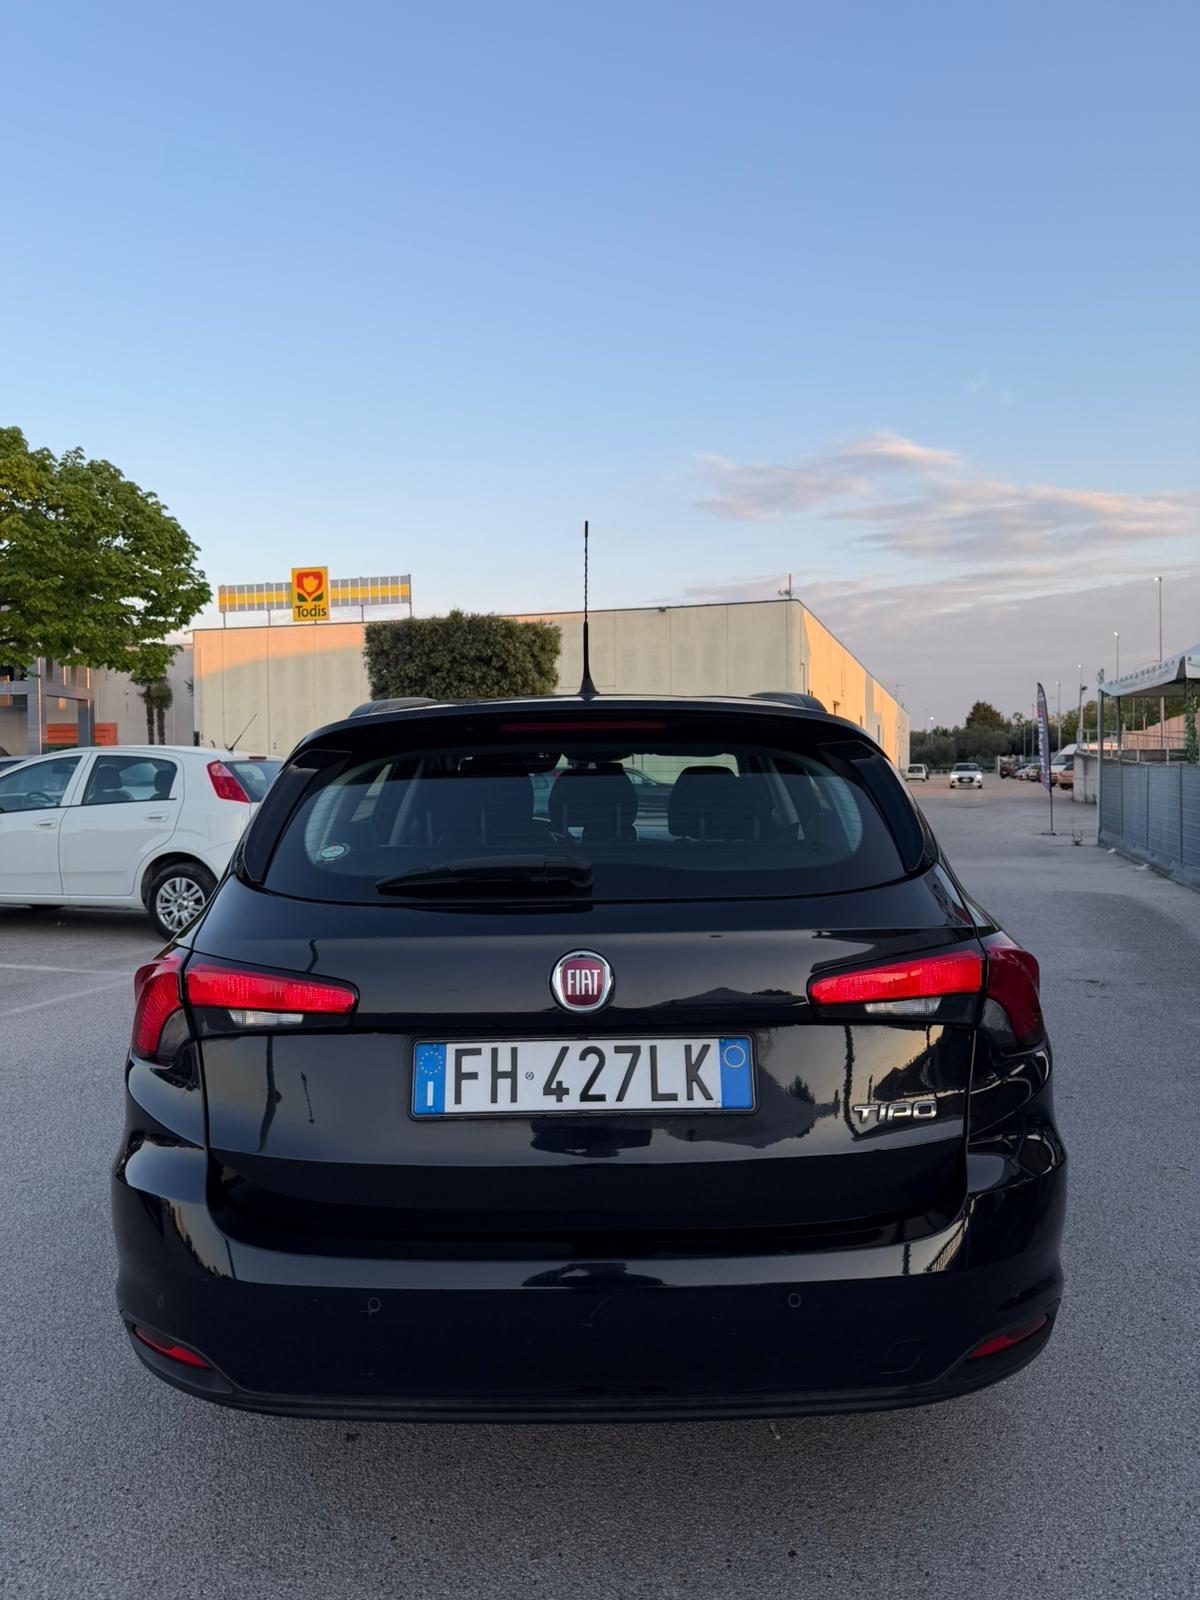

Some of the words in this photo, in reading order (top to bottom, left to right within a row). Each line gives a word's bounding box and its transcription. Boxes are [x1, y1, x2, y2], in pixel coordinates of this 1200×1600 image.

[295, 604, 327, 618] Todis
[567, 969, 601, 995] FIAT
[853, 1100, 938, 1121] TIPO
